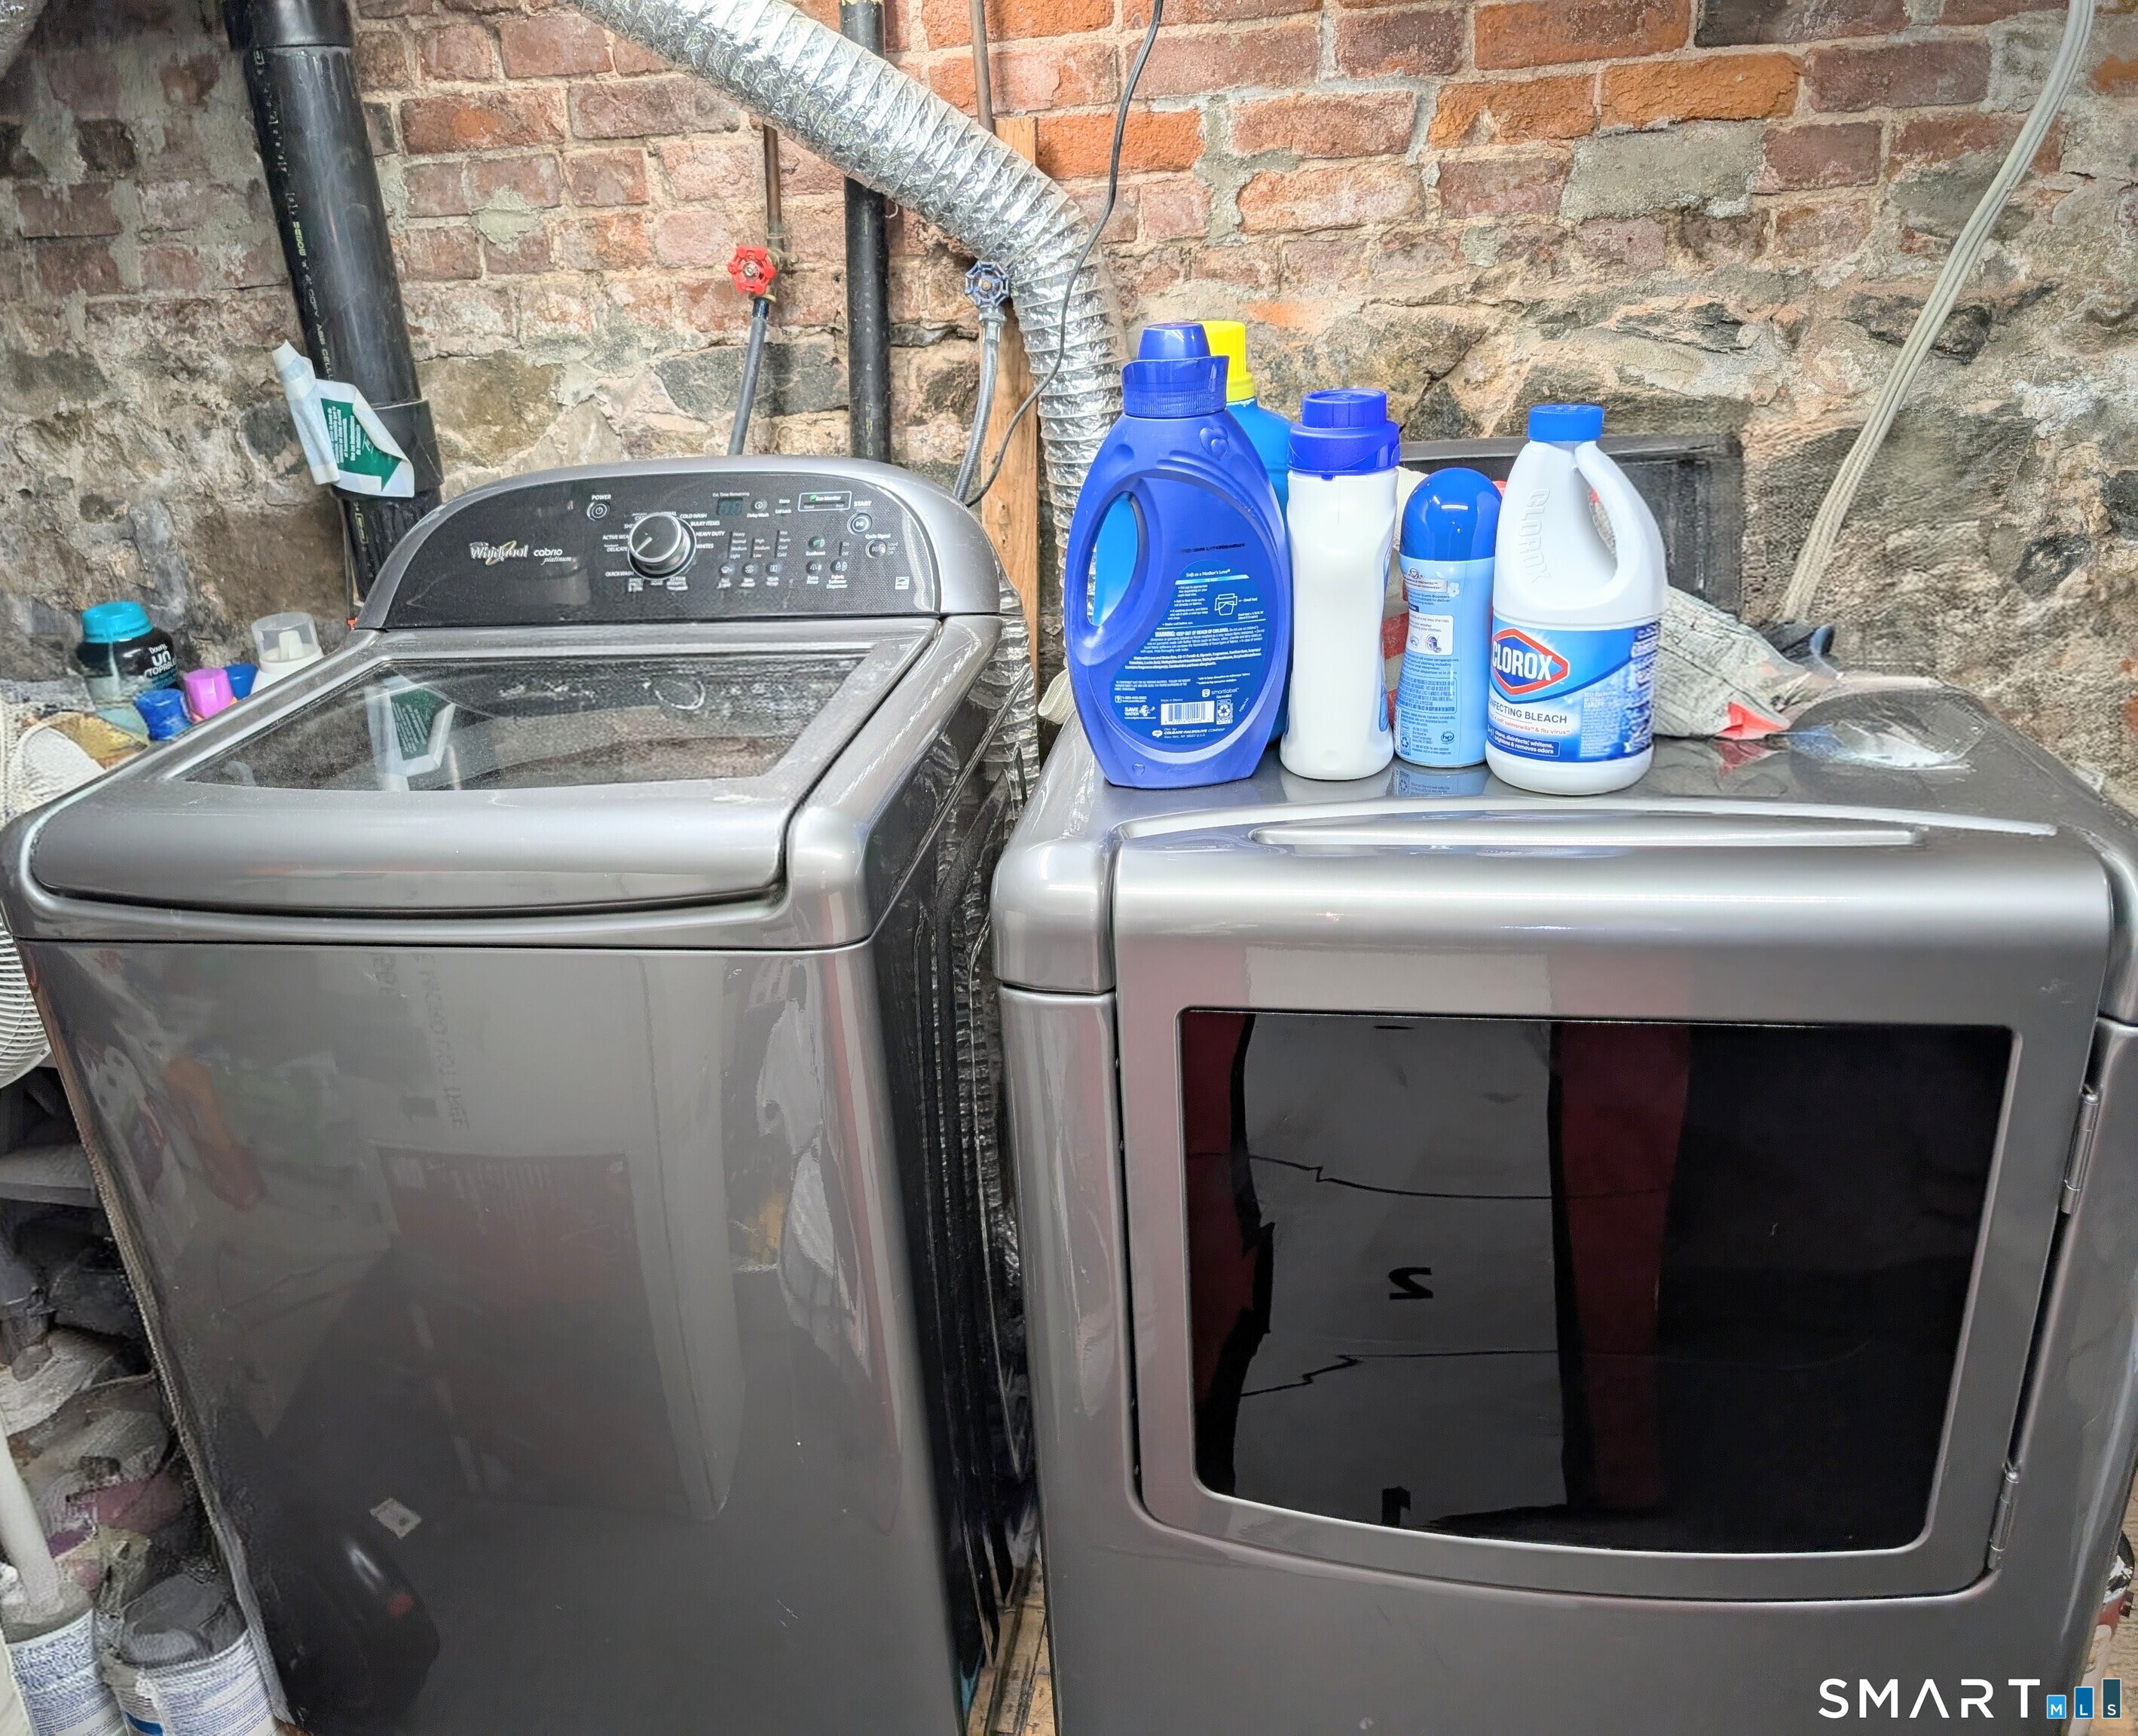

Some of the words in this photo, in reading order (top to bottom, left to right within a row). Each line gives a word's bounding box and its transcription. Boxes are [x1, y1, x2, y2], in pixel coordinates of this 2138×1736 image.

[1519, 488, 1552, 584] CLOROX
[469, 541, 529, 565] Whirlpool
[534, 547, 562, 557] cabrio
[541, 556, 572, 565] platinum
[148, 643, 168, 654] Downy
[1492, 640, 1553, 681] CLOROX
[1525, 711, 1568, 723] BLEACH
[1515, 743, 1537, 752] removes
[1530, 741, 1554, 749] whitens,
